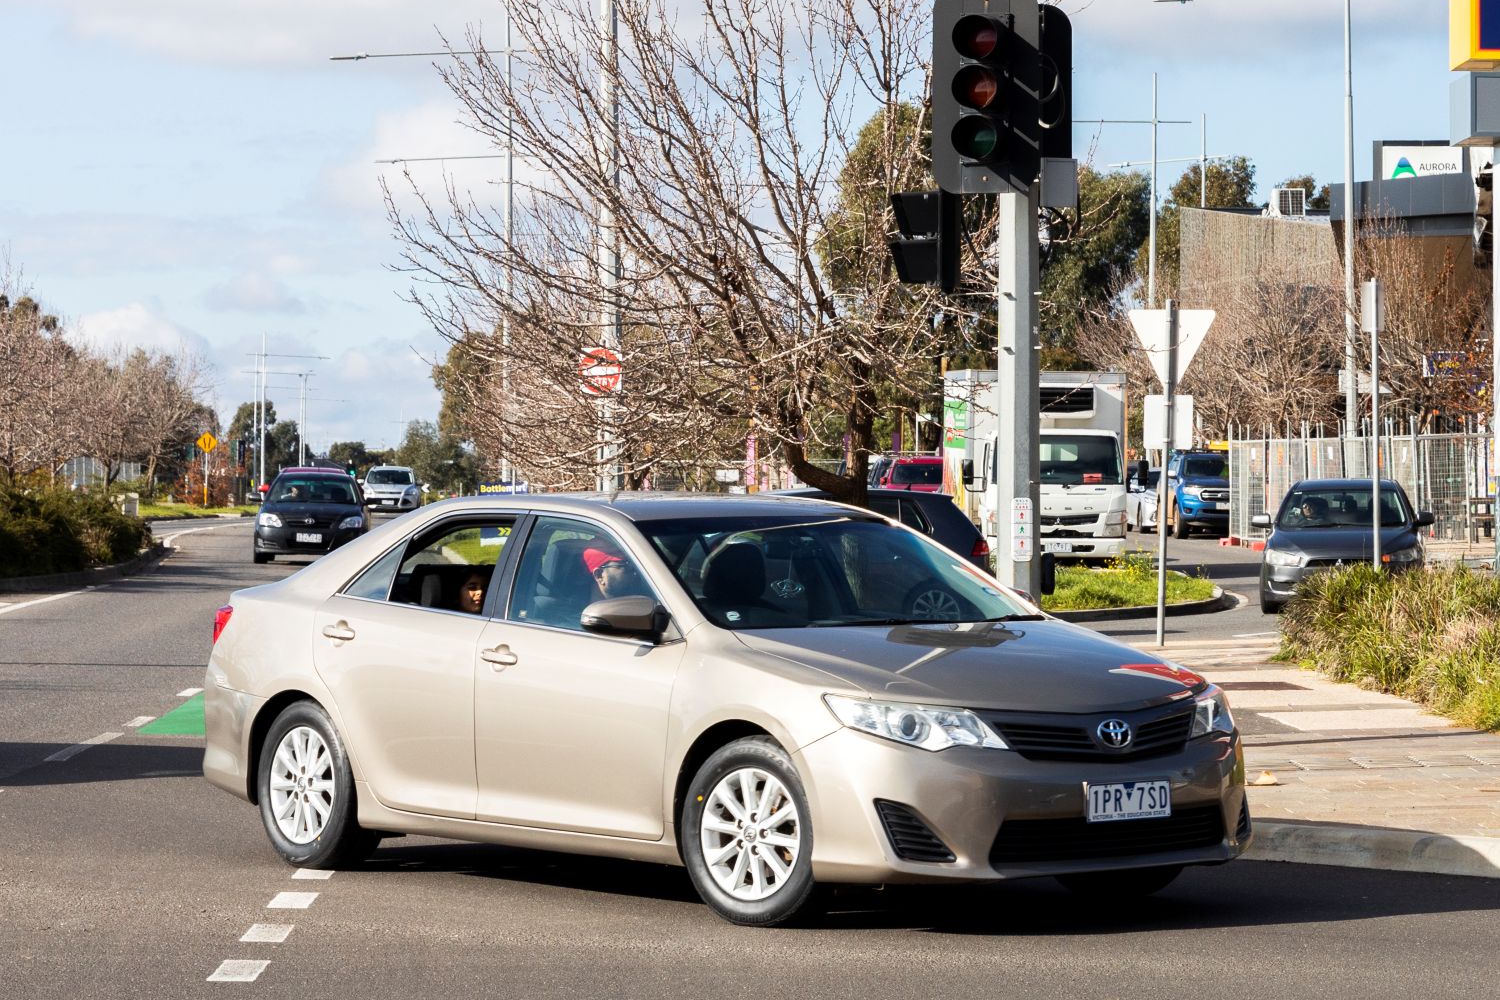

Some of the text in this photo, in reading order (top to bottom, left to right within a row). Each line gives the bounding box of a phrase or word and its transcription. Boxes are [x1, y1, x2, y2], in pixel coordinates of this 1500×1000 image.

[1419, 163, 1457, 171] AURORA
[1093, 785, 1167, 814] 1PR 7SD
